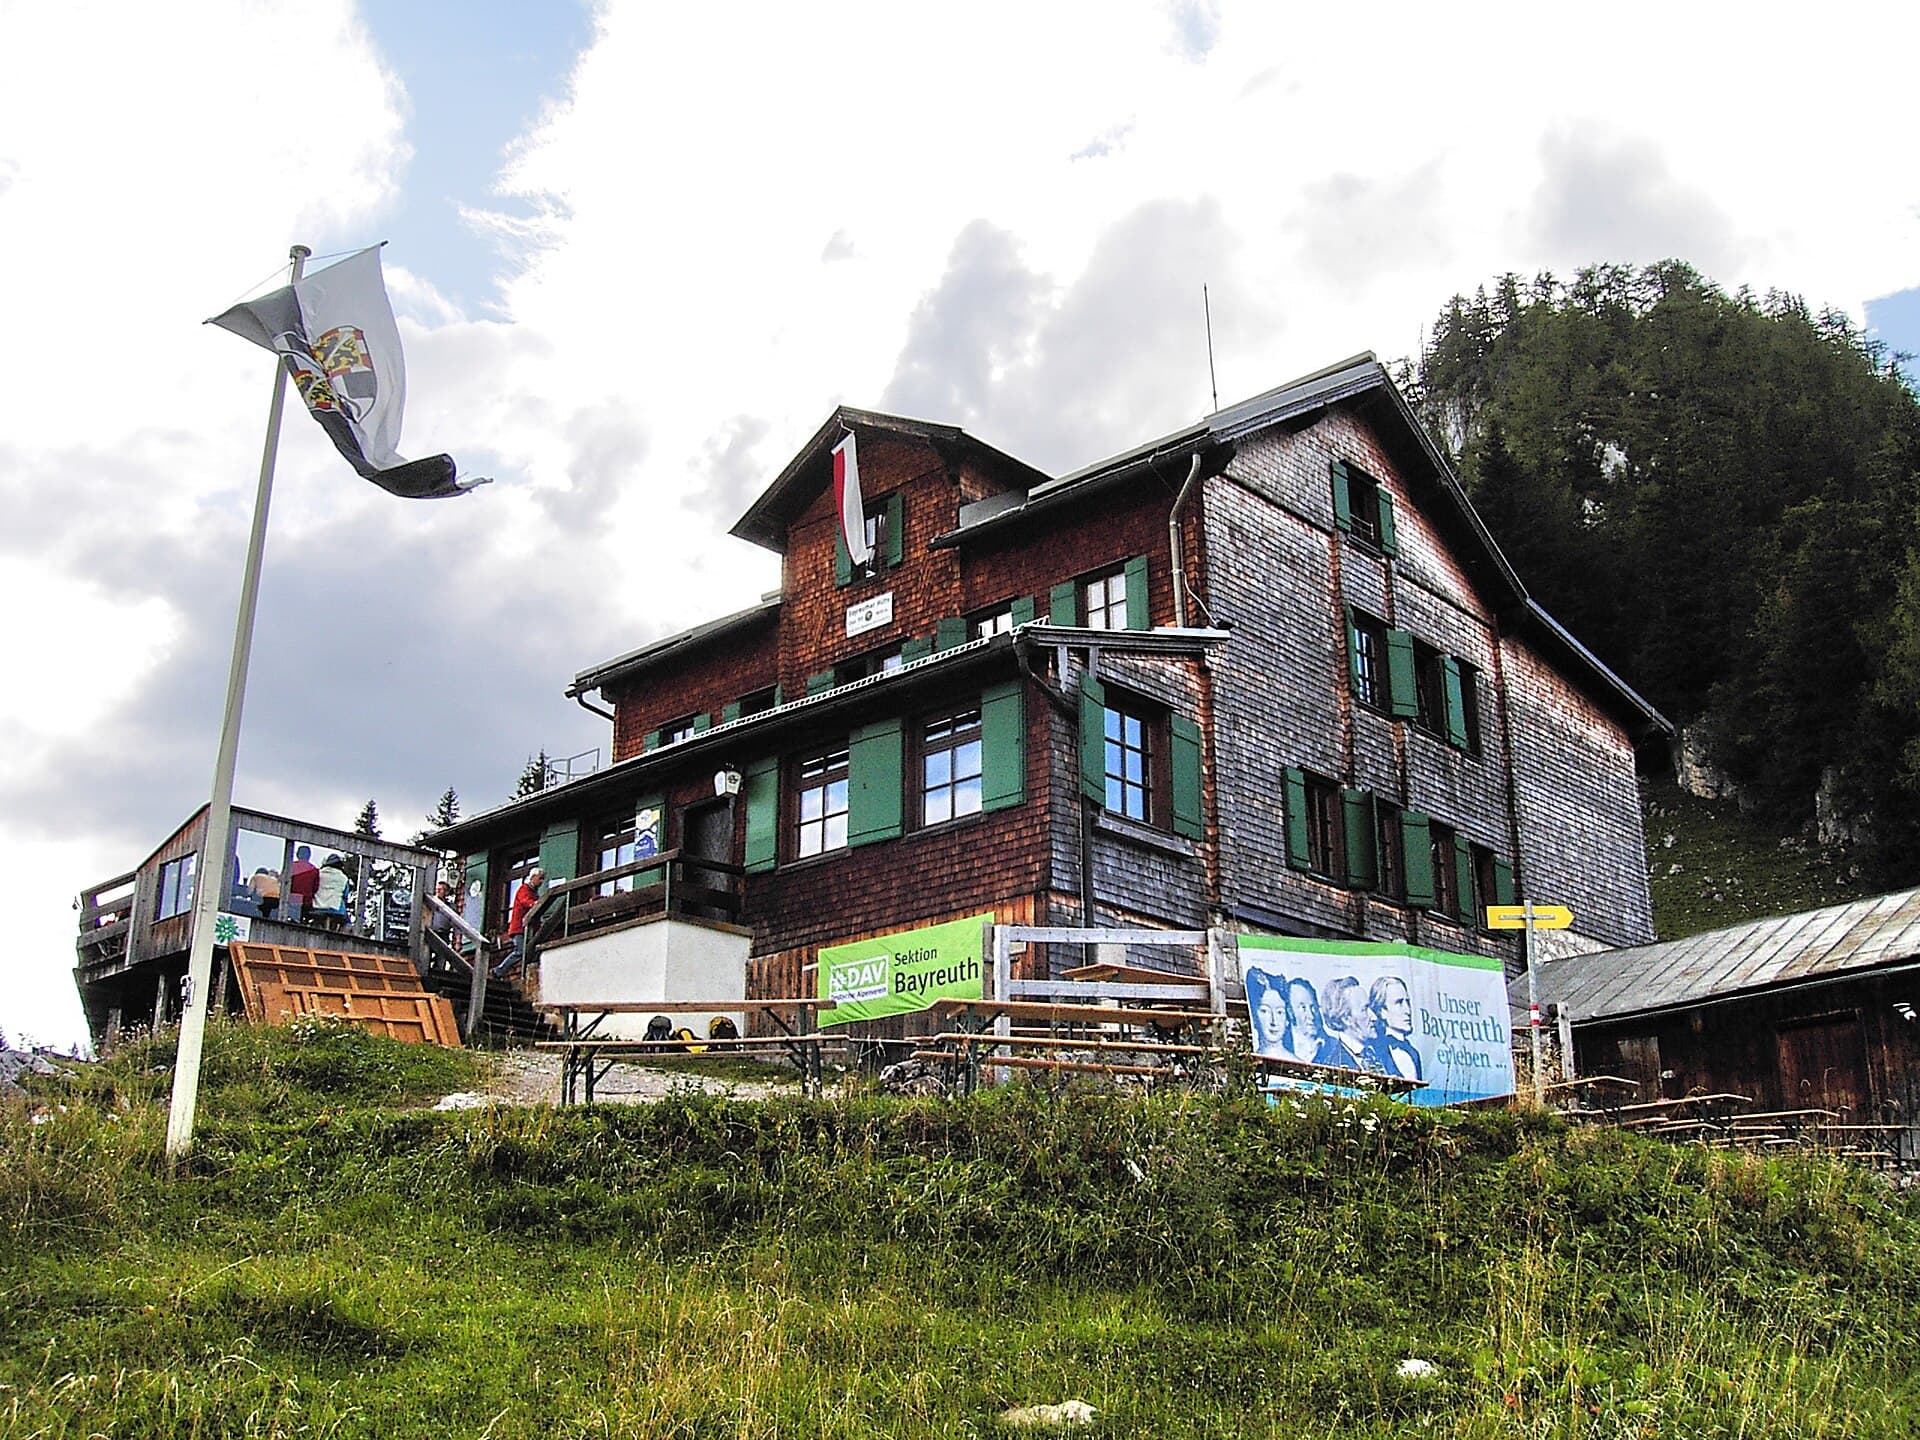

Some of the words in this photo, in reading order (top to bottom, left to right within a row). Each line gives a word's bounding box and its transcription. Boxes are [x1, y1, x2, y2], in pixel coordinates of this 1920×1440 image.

[894, 947, 937, 966] Sektion
[847, 962, 885, 987] DAV
[895, 957, 979, 995] Bayreuth
[1437, 991, 1481, 1016] Unser
[1420, 1007, 1505, 1044] Bayreuth
[1437, 1044, 1491, 1068] erleben
